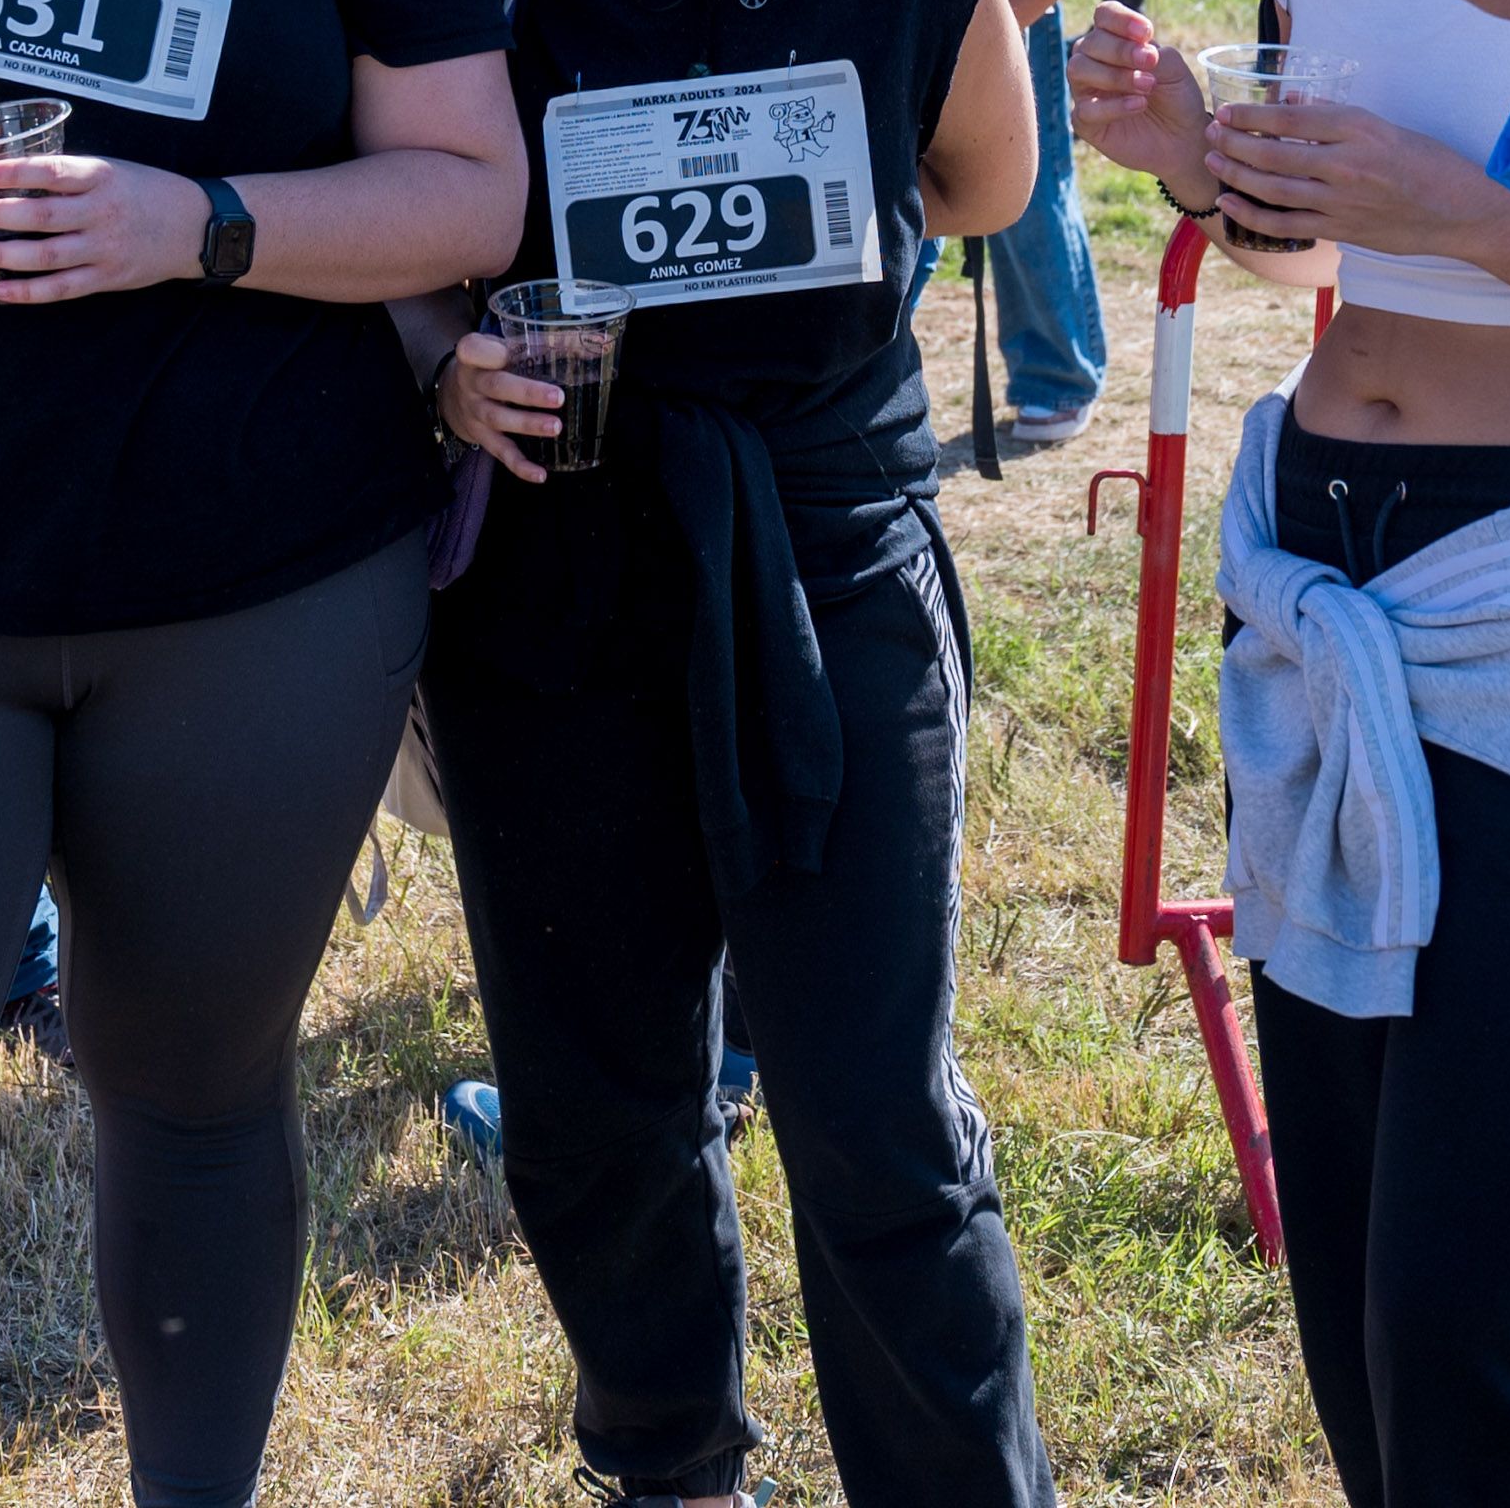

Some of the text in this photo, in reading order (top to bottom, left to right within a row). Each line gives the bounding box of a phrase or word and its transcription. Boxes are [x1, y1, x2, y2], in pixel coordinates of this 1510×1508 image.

[9, 40, 80, 66] CAZCARRA
[4, 59, 101, 89] NO EM PLASTIFIQUIS
[632, 85, 762, 107] MARXA ADULTS 2024
[673, 108, 720, 141] 75
[621, 184, 767, 264] 629
[649, 257, 742, 279] ANNA GOMEZ
[684, 273, 778, 291] NO EM PLASTIFIQUIS
